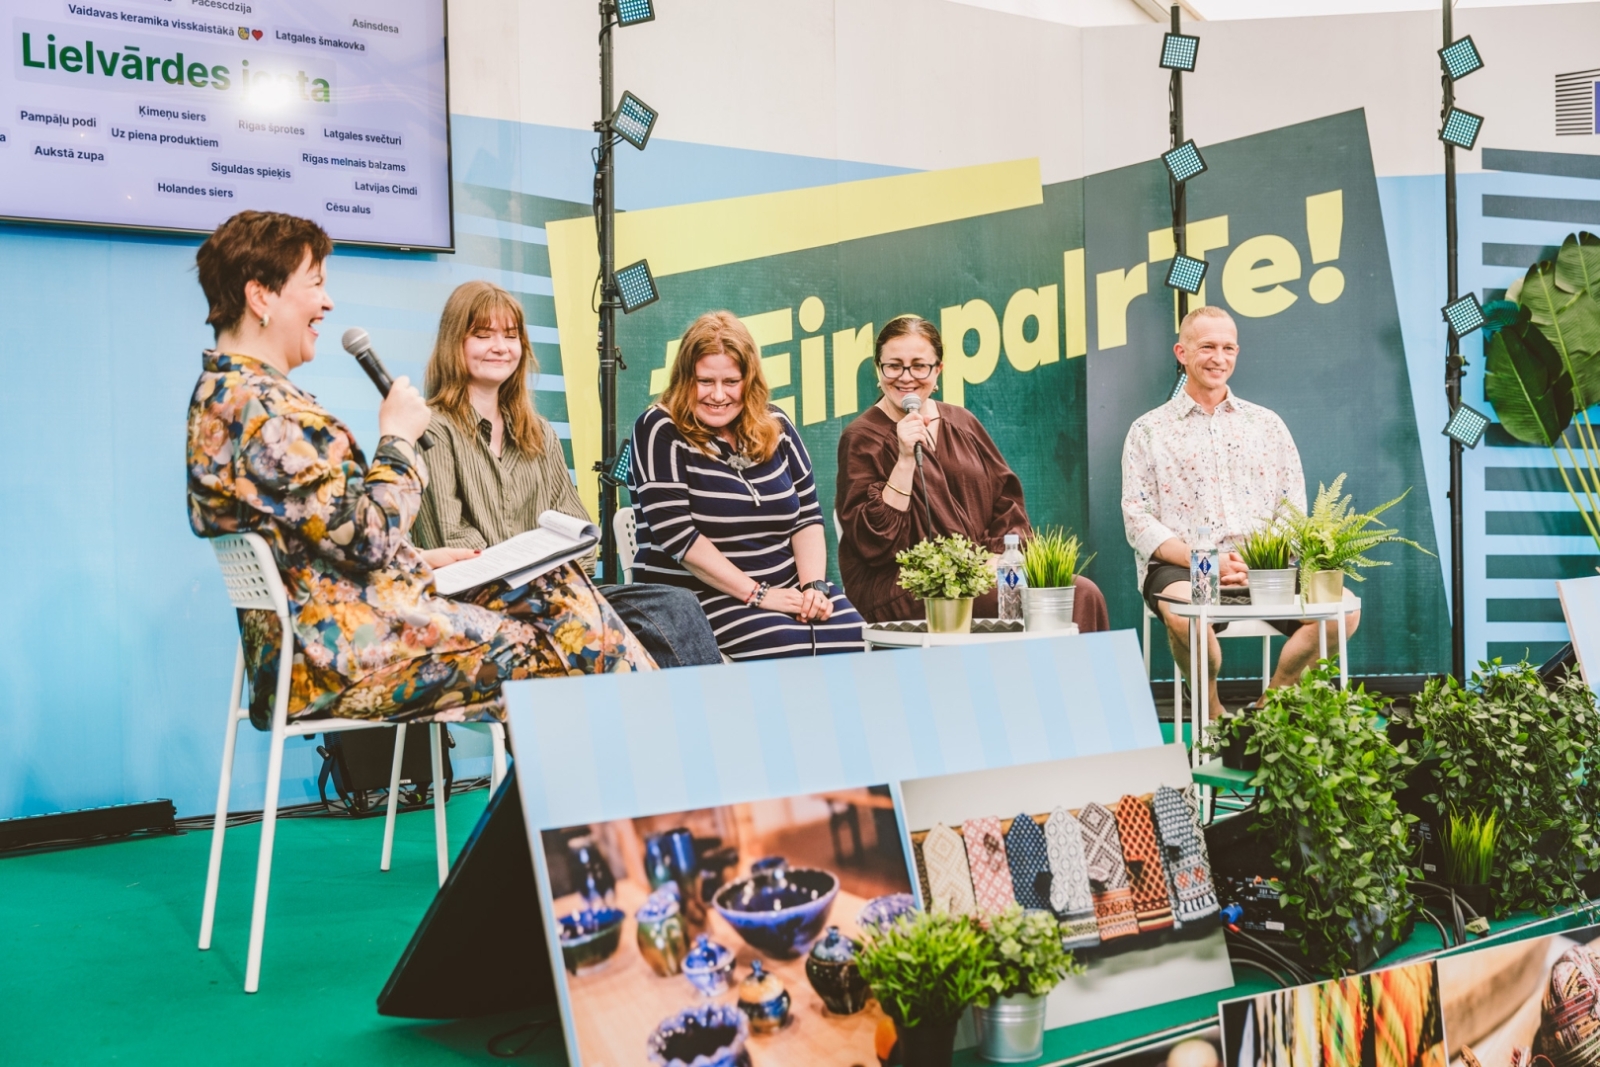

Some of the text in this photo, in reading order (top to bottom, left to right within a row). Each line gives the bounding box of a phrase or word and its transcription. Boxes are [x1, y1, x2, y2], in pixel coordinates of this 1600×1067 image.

[68, 4, 235, 37] Vaidavas keramika visskaistākā
[352, 19, 400, 34] Asinsdesa
[276, 30, 366, 52] Latgales šmakovka
[22, 31, 330, 103] Lielvārdes jta
[21, 110, 97, 128] Pampāļu podi
[139, 106, 207, 122] Ķimeņu siers
[112, 128, 219, 148] Uz piena produktiem
[324, 129, 402, 146] Latgales svečturi
[34, 146, 105, 163] Aukstā zupa
[303, 153, 407, 173] Rīgas melnais balzams
[211, 162, 292, 180] Siguldas spieķis
[158, 183, 234, 199] Holandes siers
[355, 182, 418, 196] Latvijas Cimdi
[326, 202, 372, 215] Cēsu alus
[649, 189, 1345, 427] EirpaIrTe!
